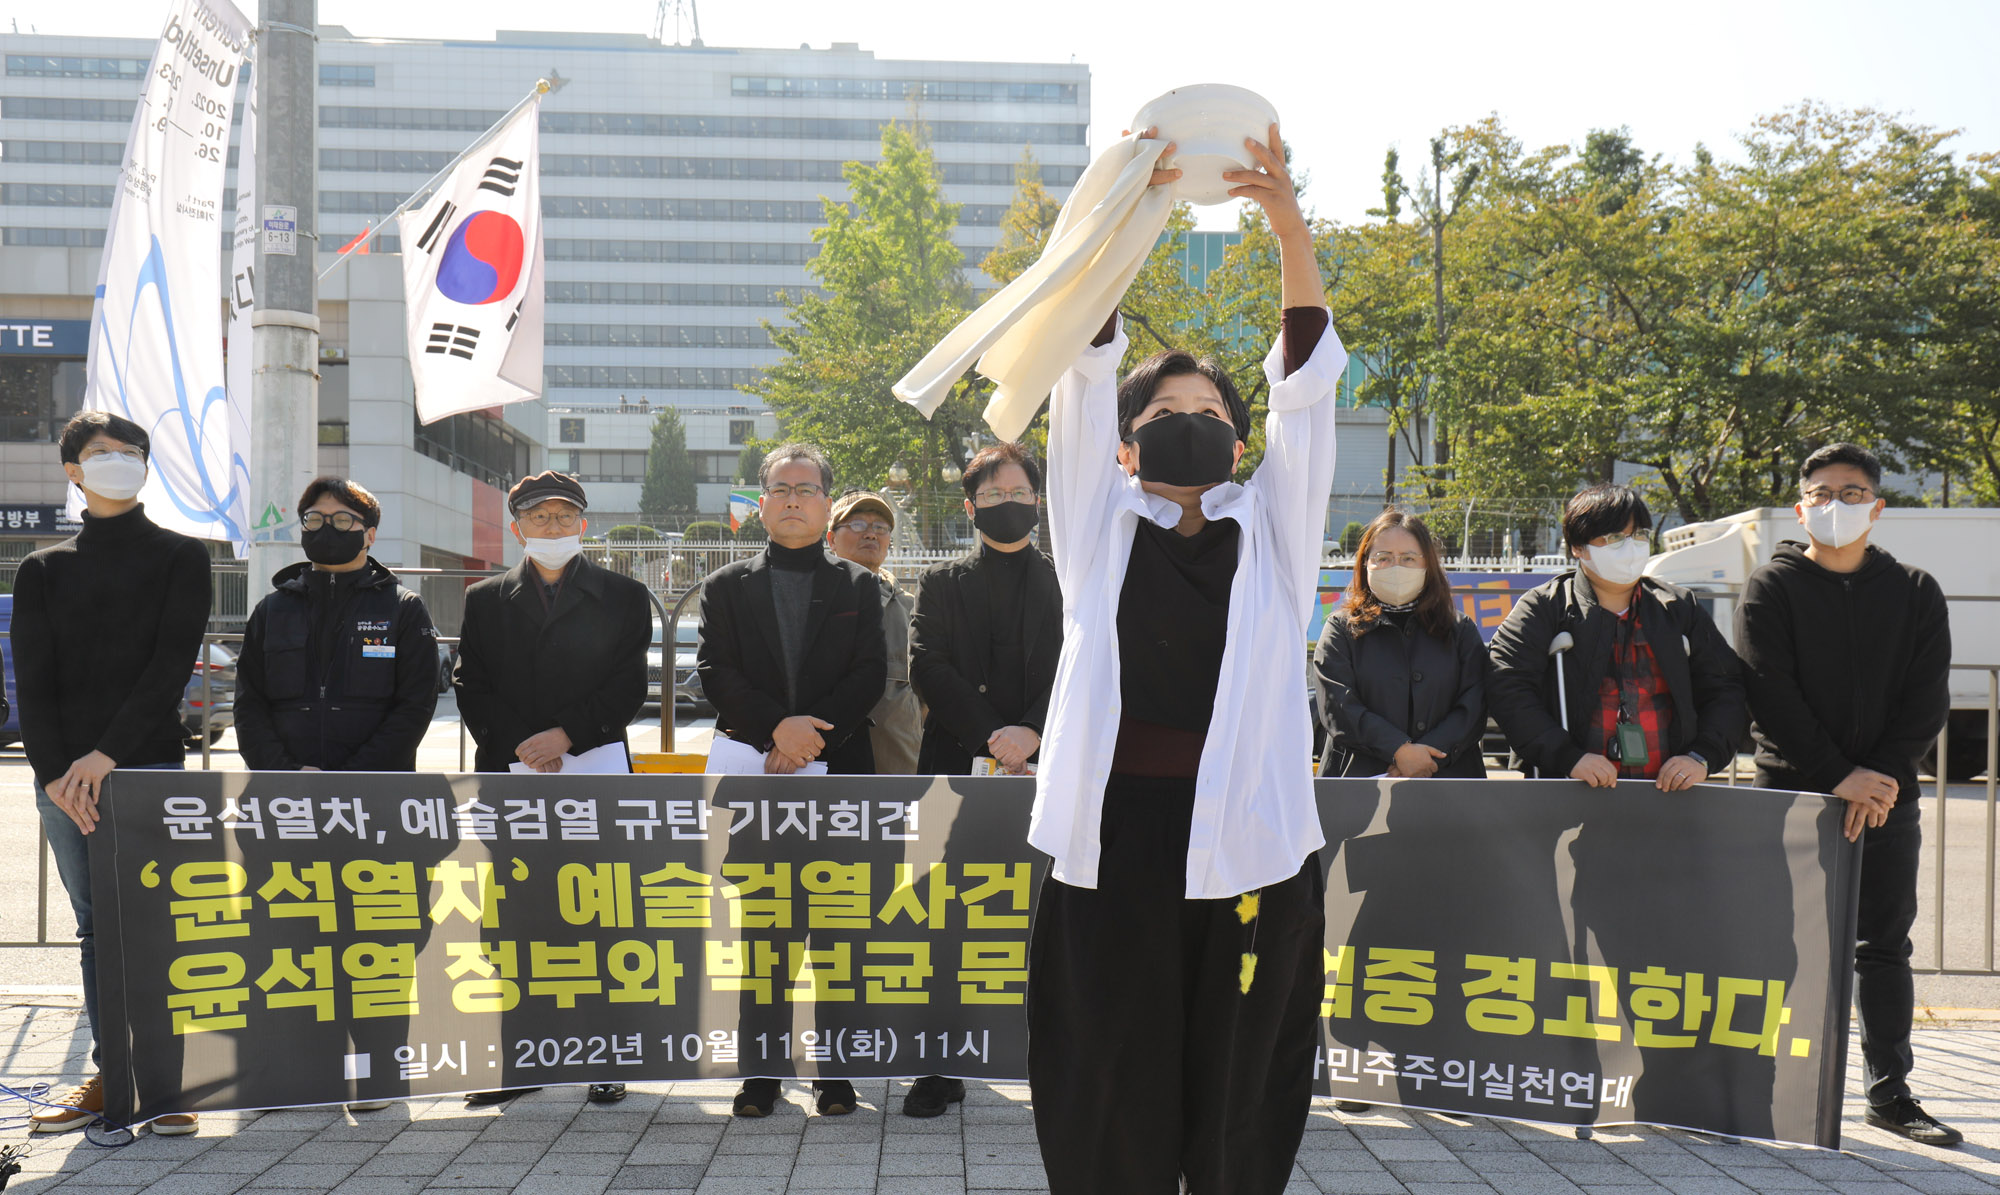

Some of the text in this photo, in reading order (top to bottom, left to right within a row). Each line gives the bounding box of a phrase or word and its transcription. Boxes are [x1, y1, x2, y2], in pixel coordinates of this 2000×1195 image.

[268, 232, 290, 243] 6-13
[0, 510, 41, 529] 방부
[163, 796, 921, 845] 윤석열차, 예술검열 규탄 기자회견
[556, 859, 1032, 930] 예술검열사건
[166, 942, 421, 1036] 윤석열
[444, 940, 684, 1014] 정부와
[704, 940, 935, 1006] 박보균
[1460, 953, 1813, 1059] 경고한다.
[393, 1039, 469, 1081] 일시
[515, 1032, 644, 1069] 2022년
[661, 1028, 740, 1064] 10월
[755, 1026, 899, 1065] 11일(화)
[914, 1028, 990, 1064] 11시
